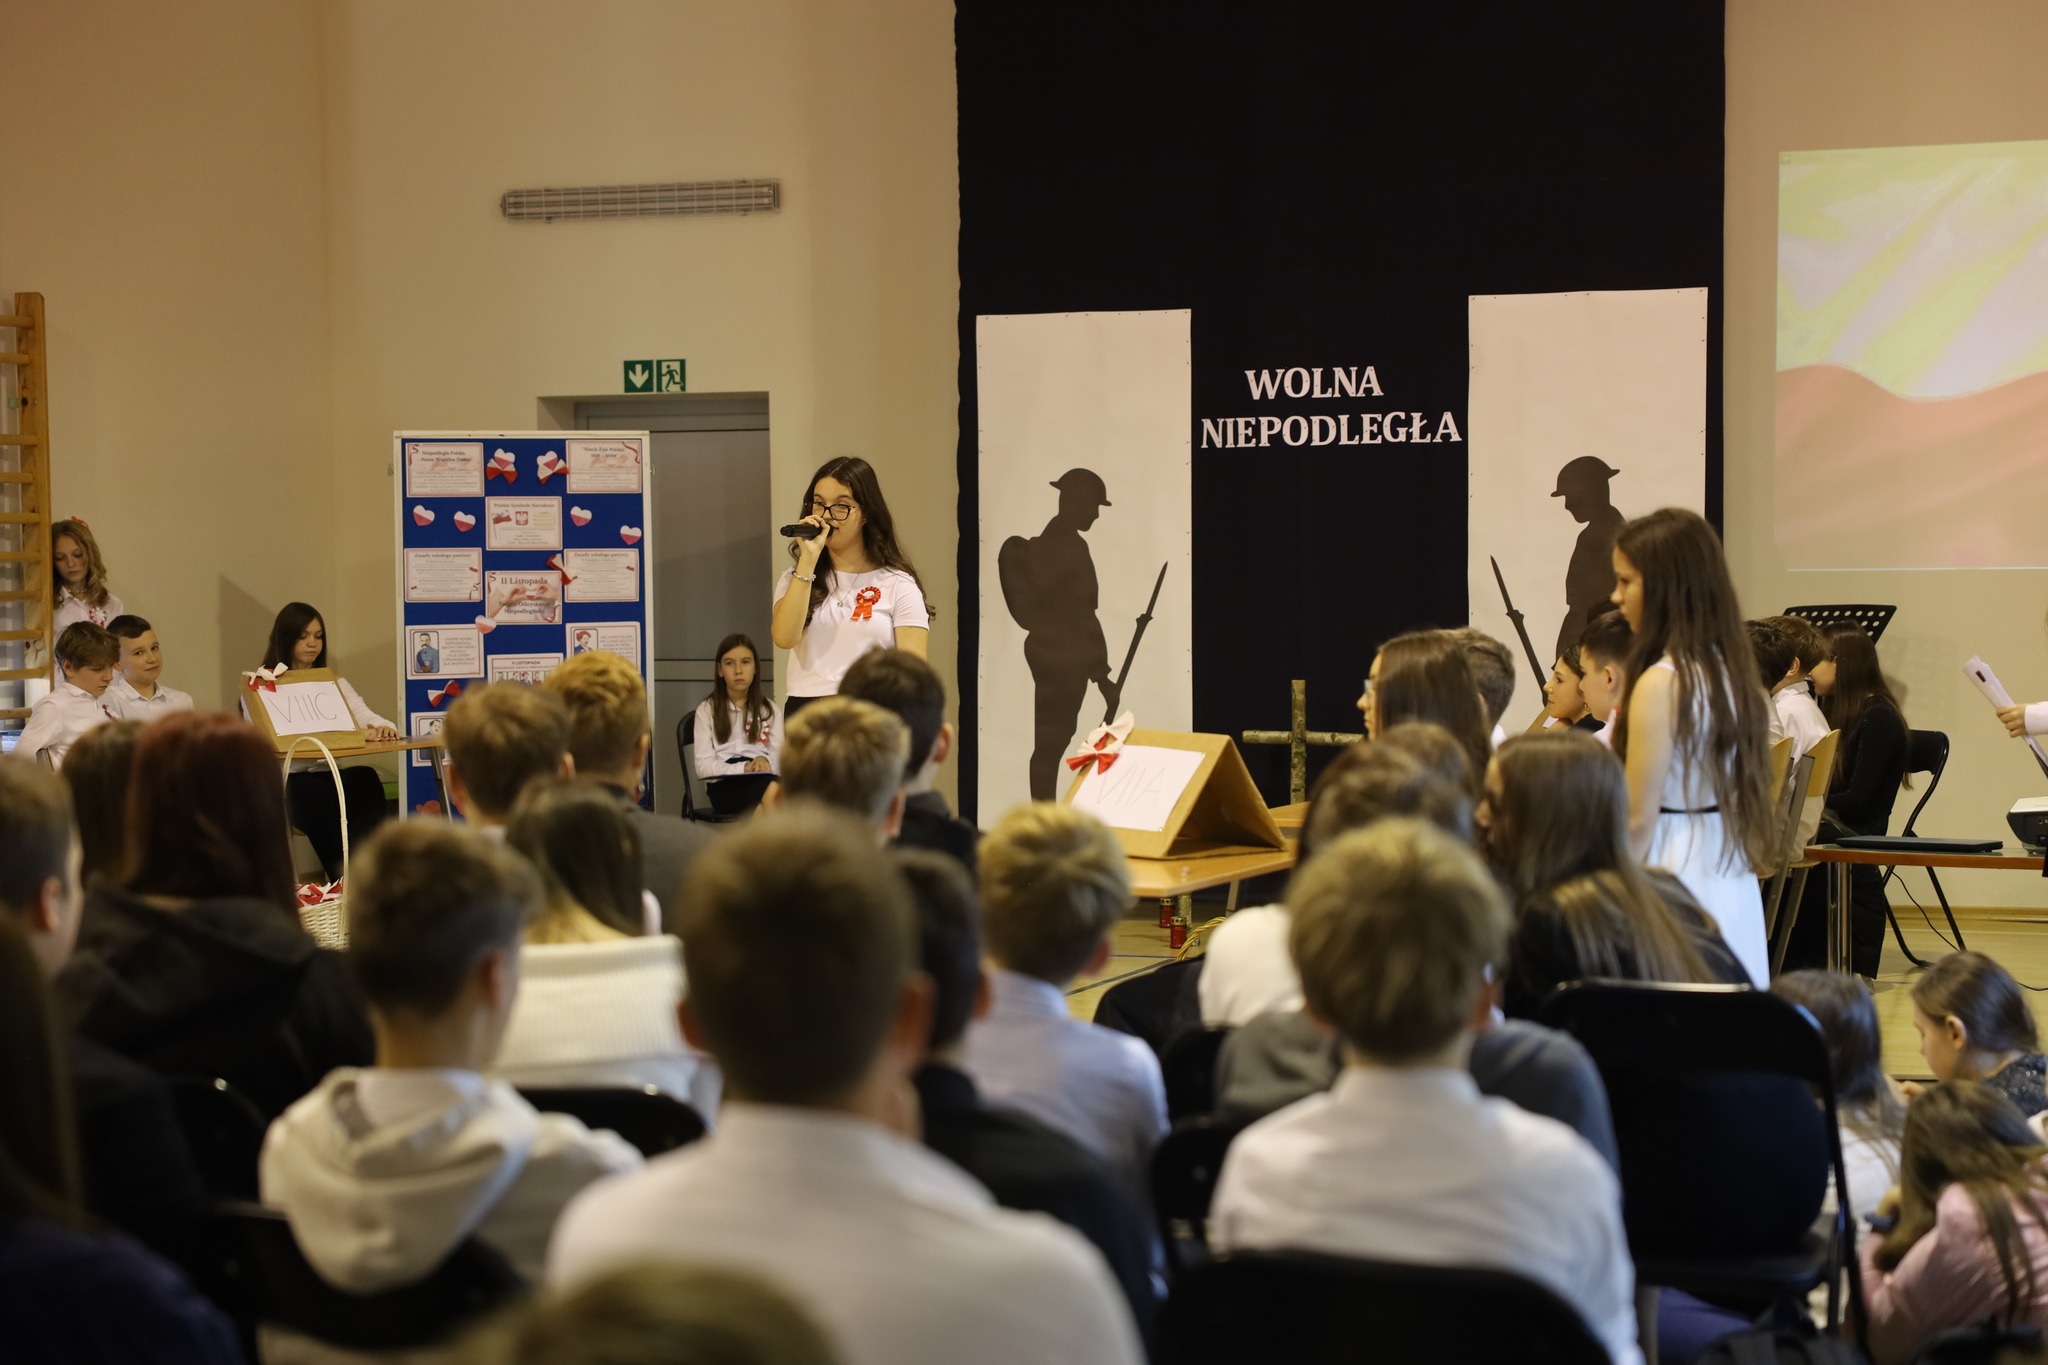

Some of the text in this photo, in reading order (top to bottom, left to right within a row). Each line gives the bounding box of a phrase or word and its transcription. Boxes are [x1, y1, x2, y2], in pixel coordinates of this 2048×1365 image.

[1245, 366, 1384, 400] WOLNA
[1201, 411, 1463, 448] NIEPODLEGŁA
[509, 577, 549, 586] Listopada
[267, 692, 338, 724] VIIIC
[1097, 763, 1167, 808] VIIA
